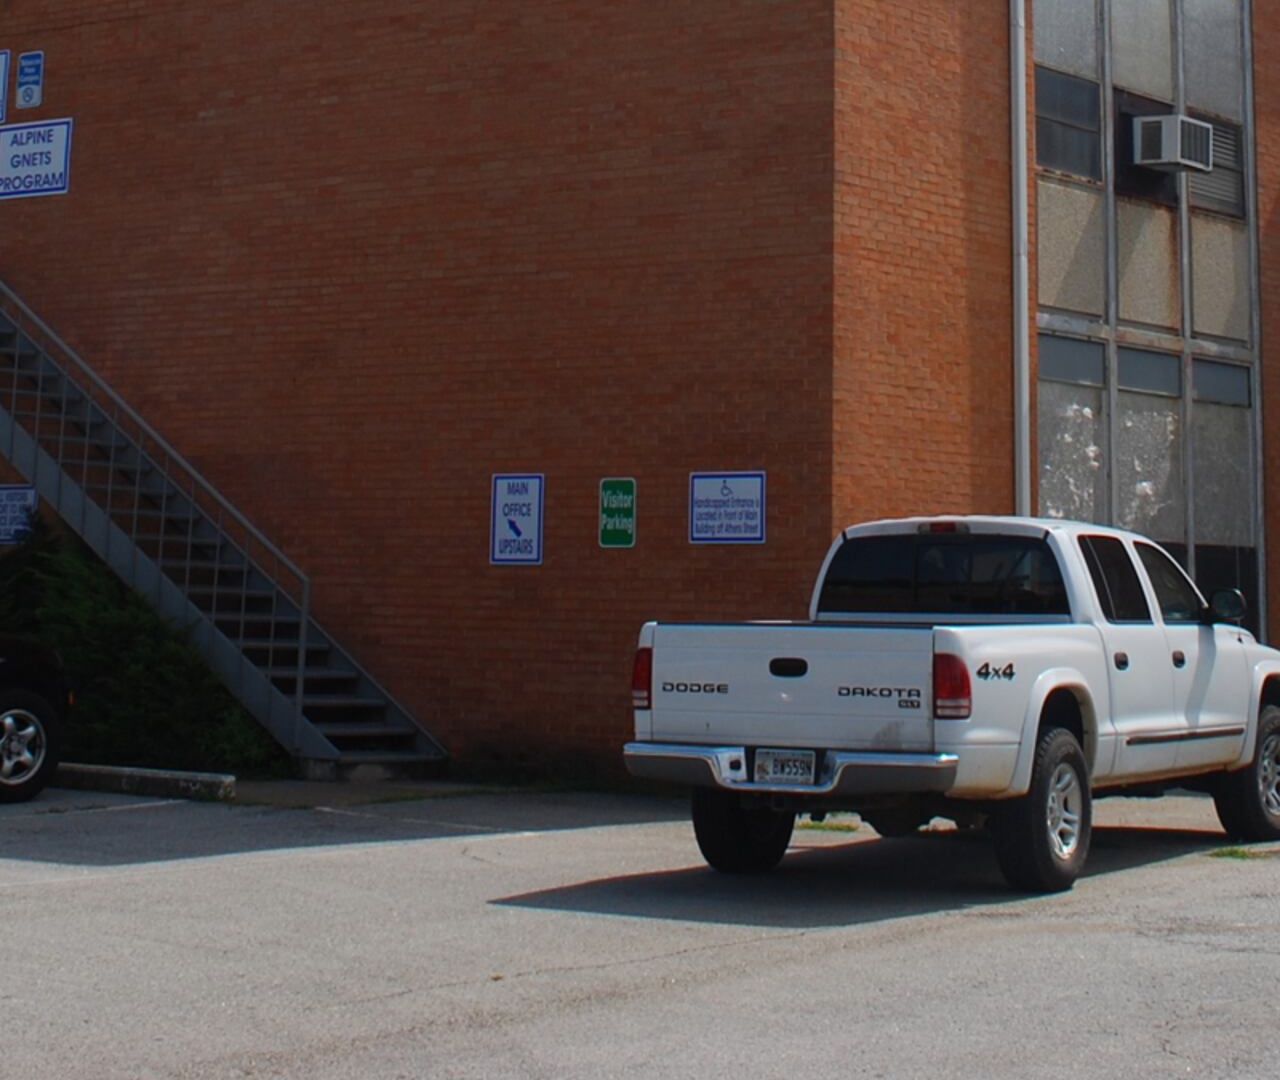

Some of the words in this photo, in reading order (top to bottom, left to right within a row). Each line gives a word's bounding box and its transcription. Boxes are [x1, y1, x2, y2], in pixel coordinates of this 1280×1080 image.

[10, 129, 54, 147] ALPINE
[10, 151, 52, 169] GNETS
[507, 482, 529, 495] MAIN
[602, 490, 633, 508] Visitor
[503, 503, 532, 516] OFFICE
[601, 513, 633, 534] Parking
[499, 538, 533, 554] UPSTAIRS
[976, 662, 1016, 681] 4x4
[662, 682, 729, 694] DODGE
[837, 686, 921, 699] DAKOTA
